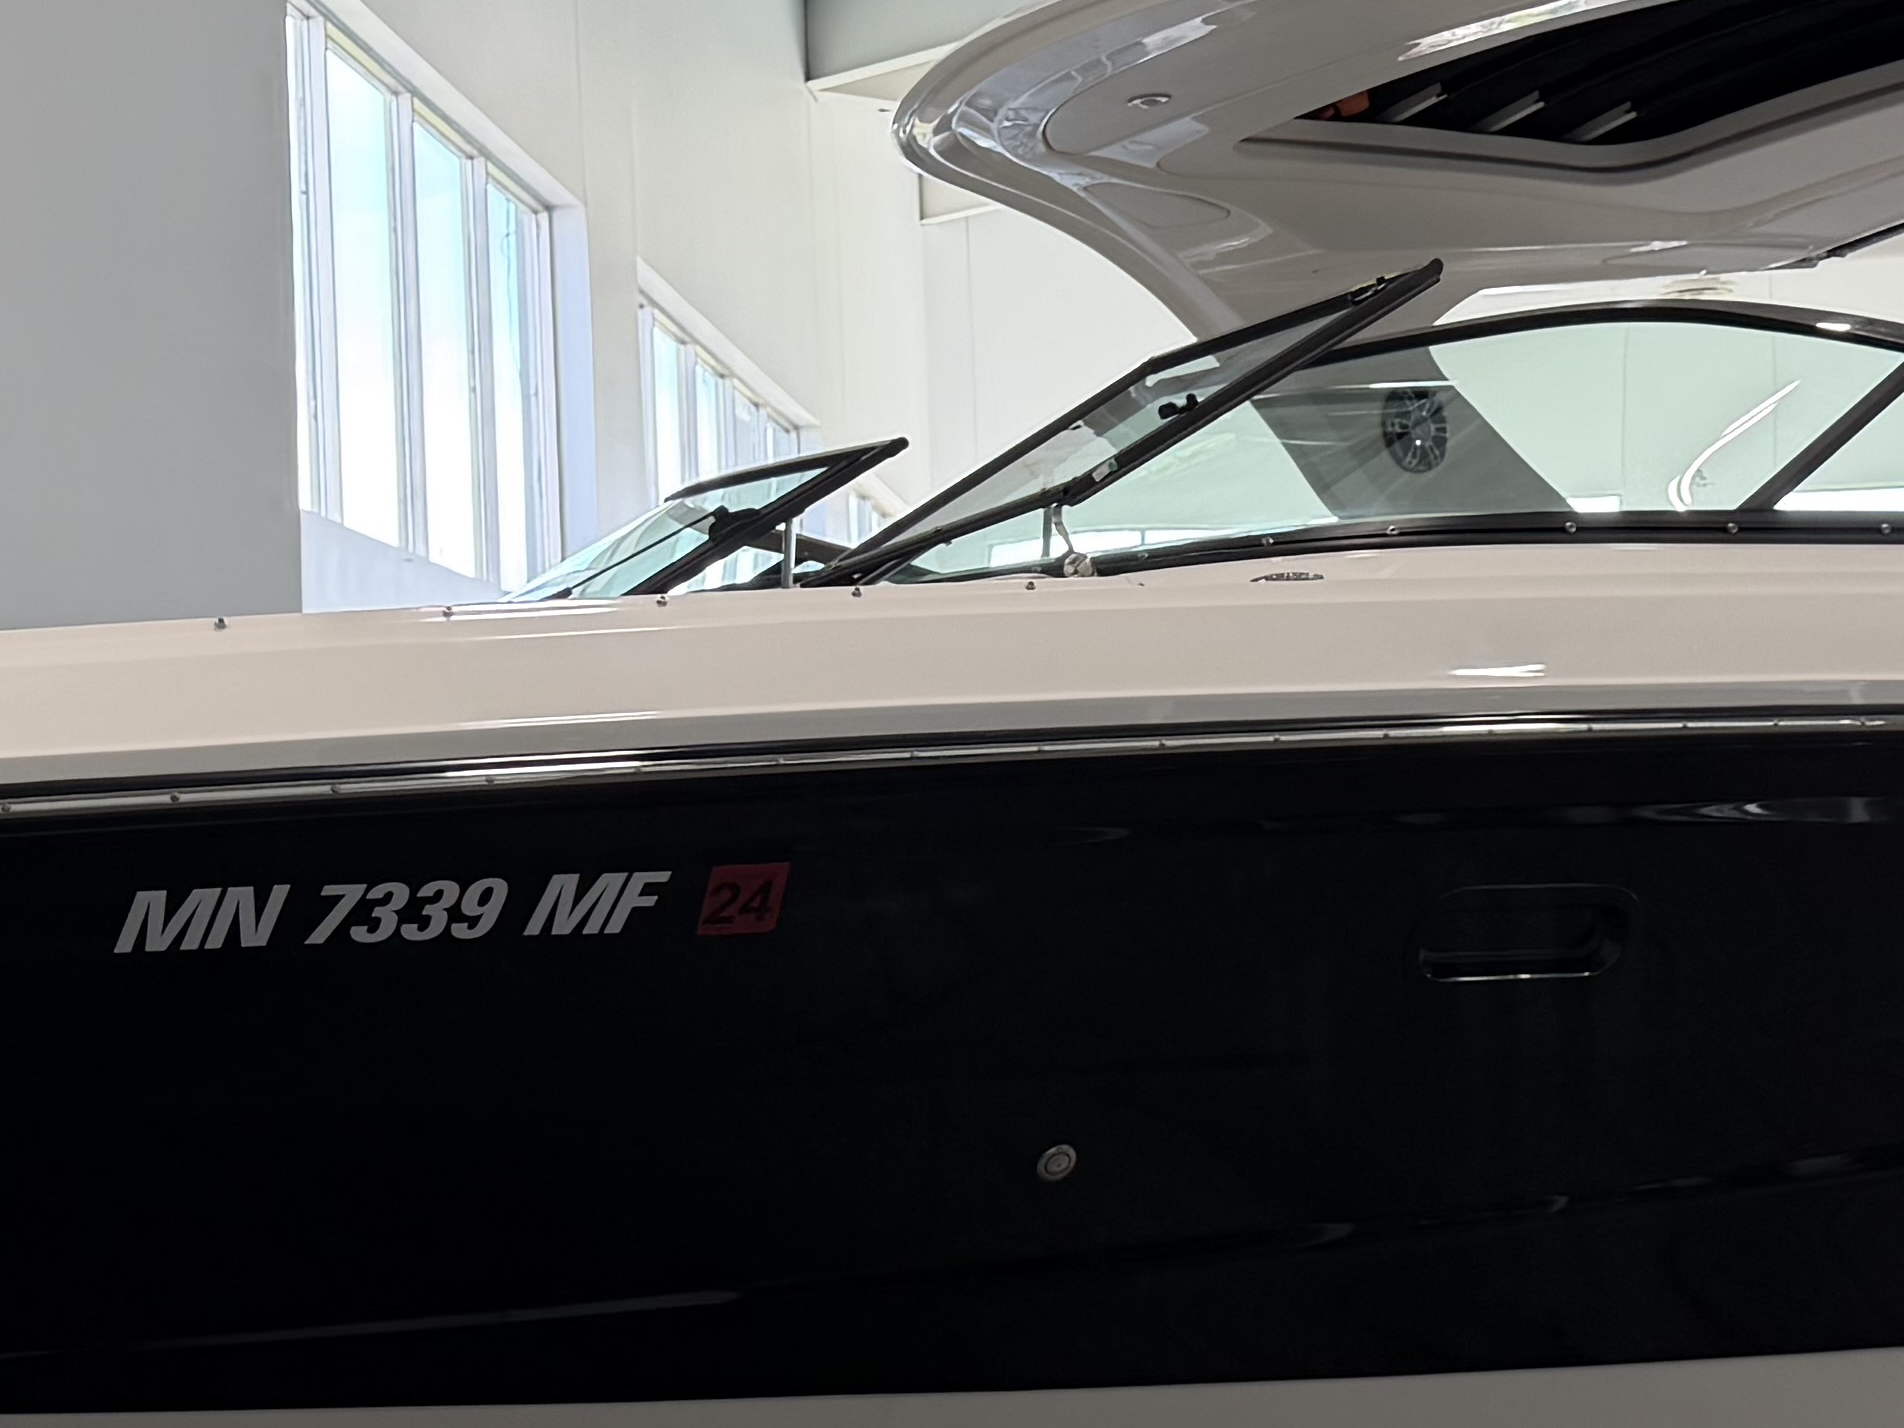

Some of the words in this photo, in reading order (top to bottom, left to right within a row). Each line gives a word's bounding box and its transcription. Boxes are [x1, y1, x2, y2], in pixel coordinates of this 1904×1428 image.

[113, 884, 290, 953] MN
[304, 877, 508, 944] 7339
[523, 870, 672, 935] MF
[701, 880, 773, 925] 24
